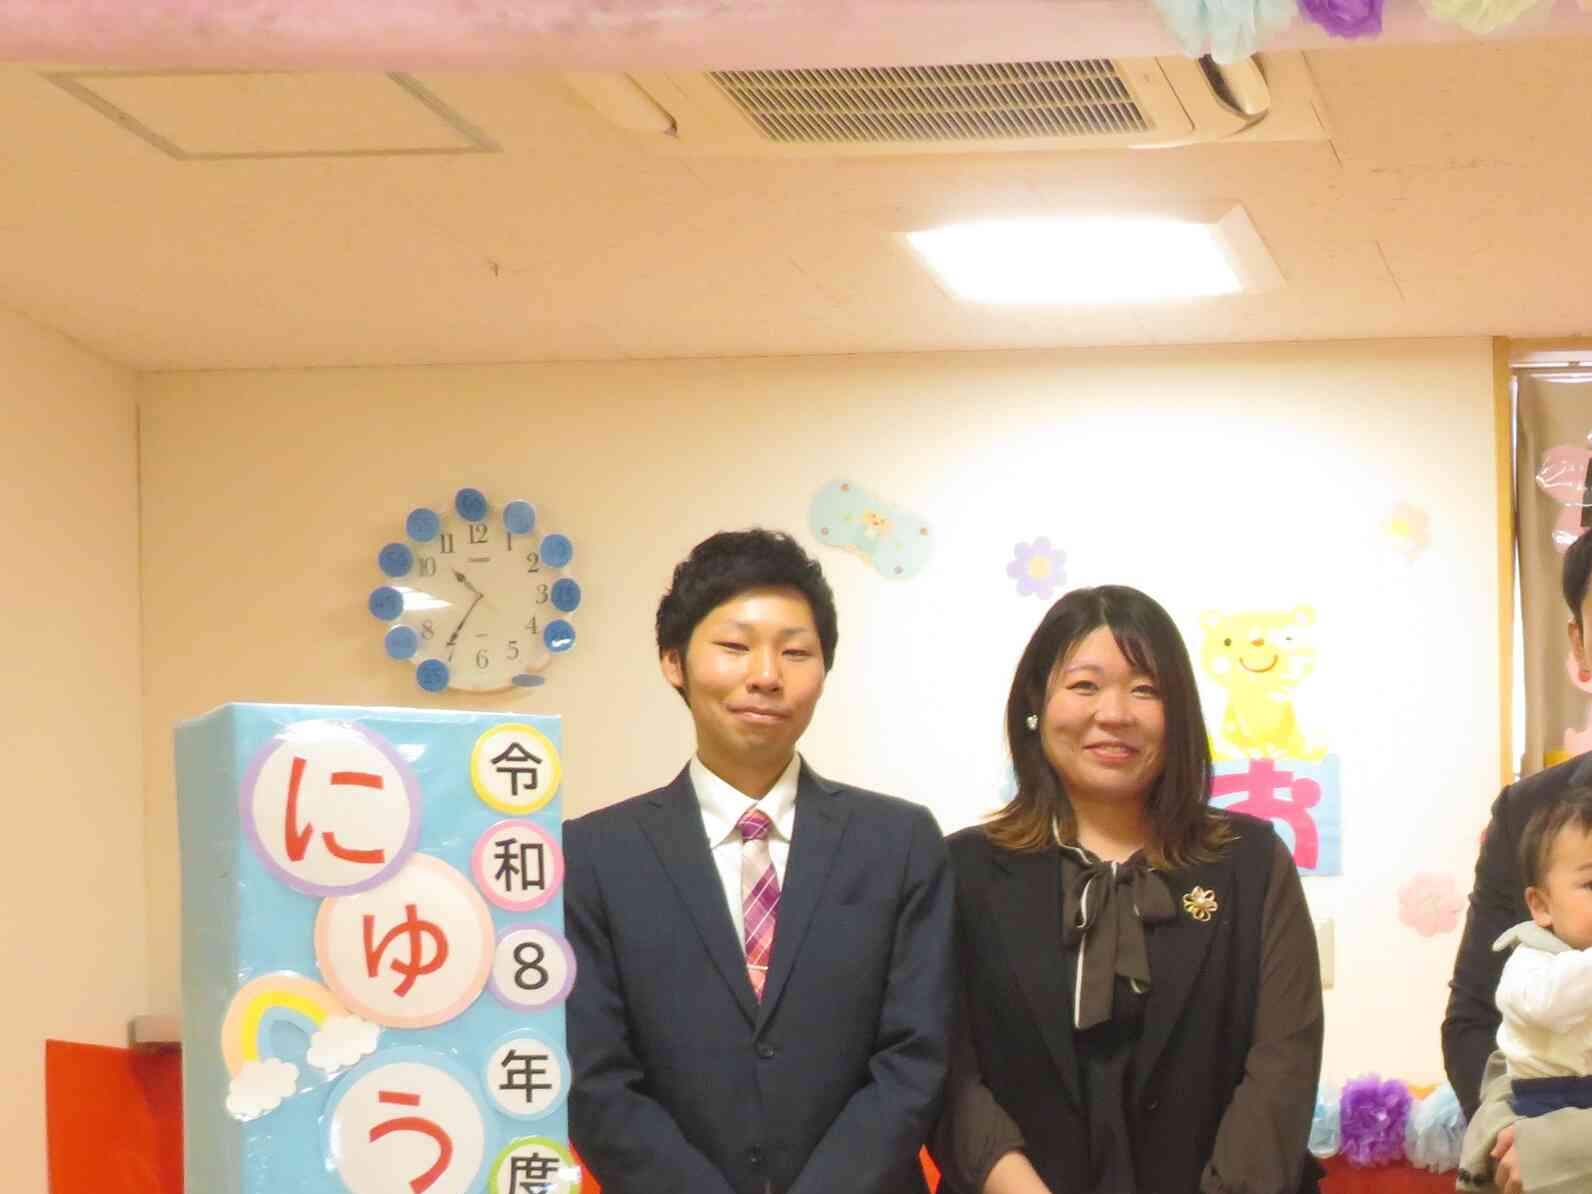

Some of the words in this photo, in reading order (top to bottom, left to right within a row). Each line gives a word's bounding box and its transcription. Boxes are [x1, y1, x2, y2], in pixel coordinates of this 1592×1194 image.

[440, 533, 455, 553] 11
[467, 524, 488, 544] 12
[507, 532, 513, 551] 1
[418, 556, 436, 577] 10
[526, 552, 539, 572] 2
[536, 584, 548, 604] 3
[421, 620, 434, 640] 8
[525, 616, 538, 635] 4
[476, 649, 489, 669] 6
[506, 641, 519, 660] 5
